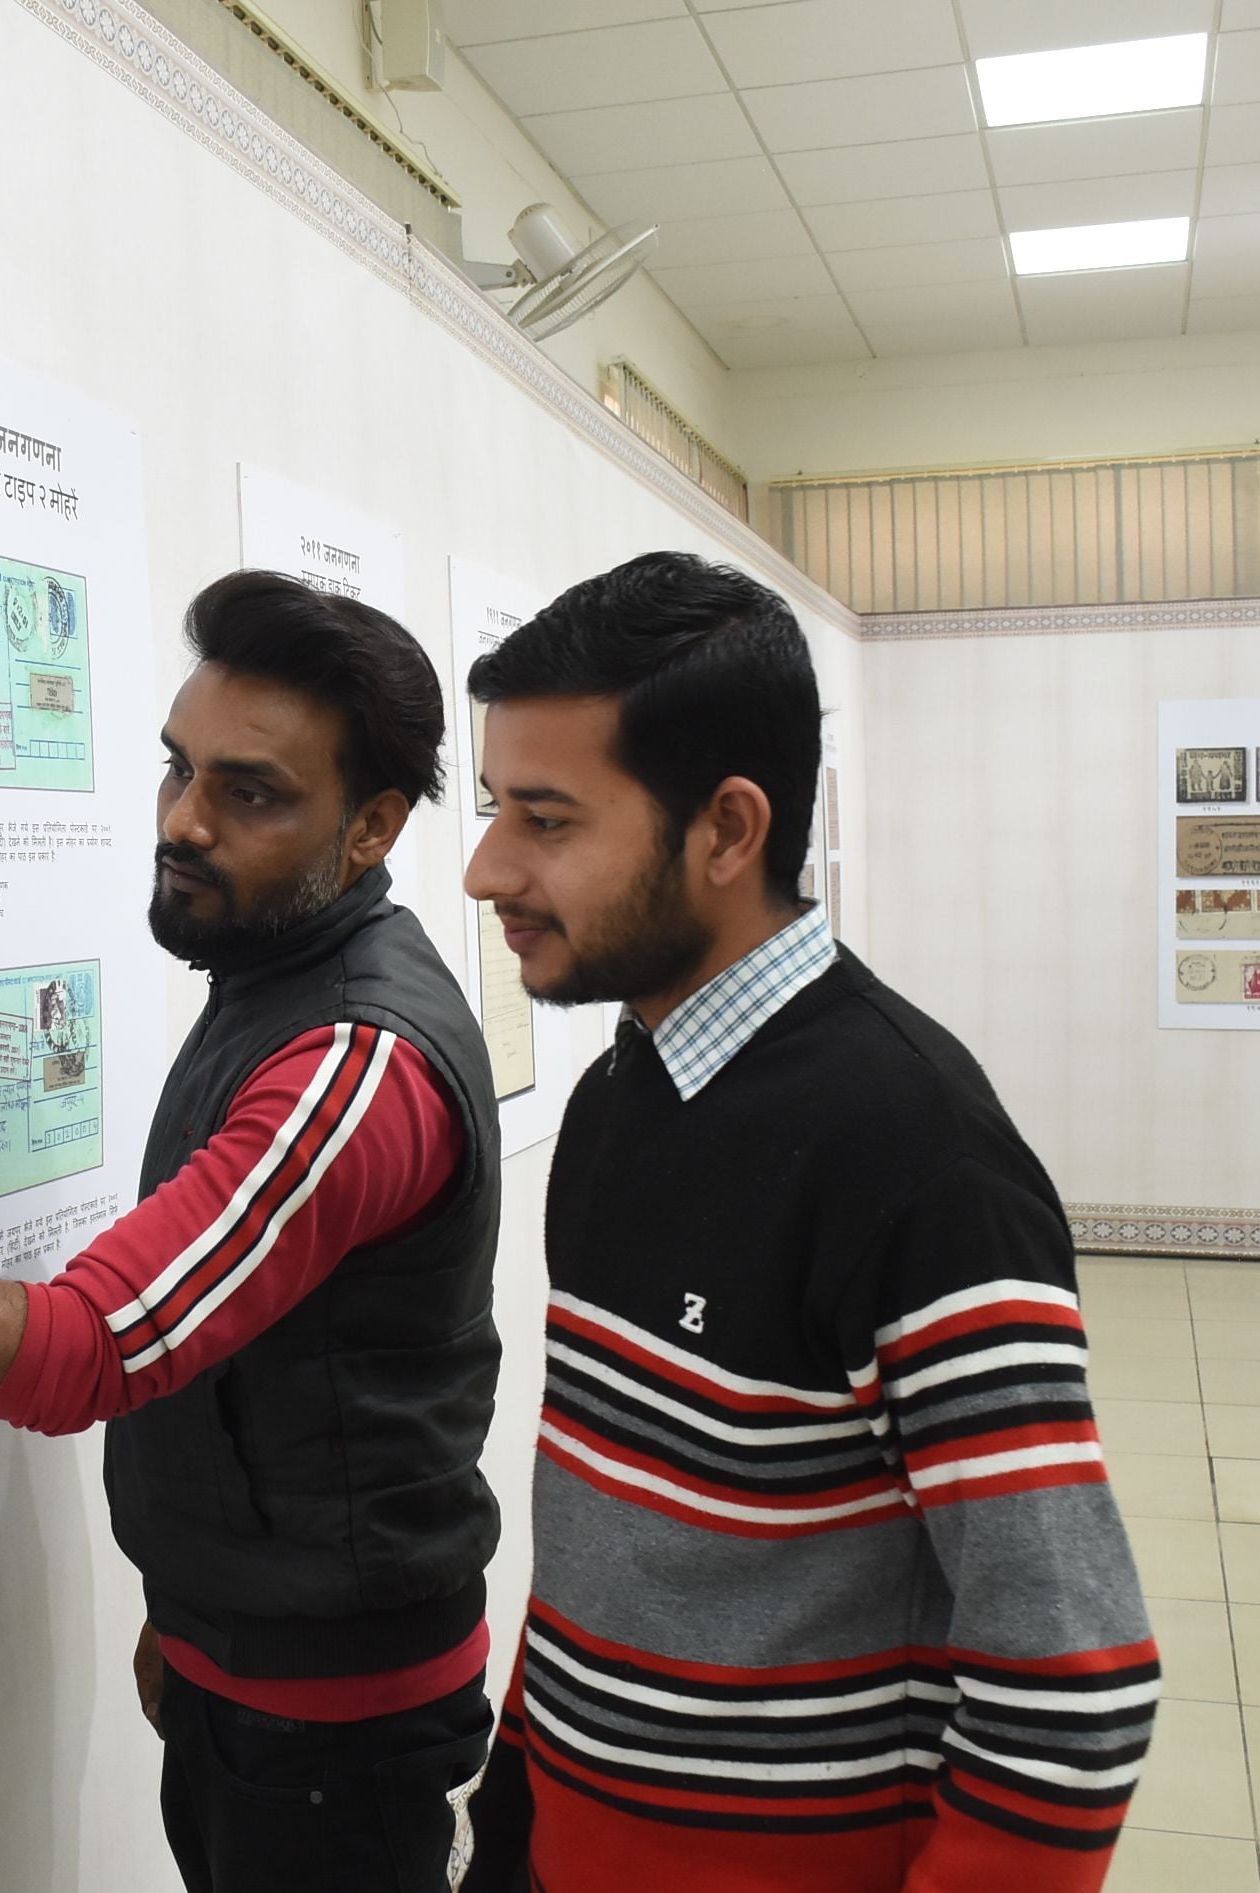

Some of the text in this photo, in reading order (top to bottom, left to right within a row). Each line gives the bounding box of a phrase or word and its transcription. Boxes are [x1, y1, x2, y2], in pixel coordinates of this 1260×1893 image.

[3, 473, 36, 509] टाइप
[38, 484, 46, 509] २
[48, 482, 79, 521] मोहरें
[300, 535, 360, 574] २०११ जनगणना
[678, 1292, 707, 1334] Z
